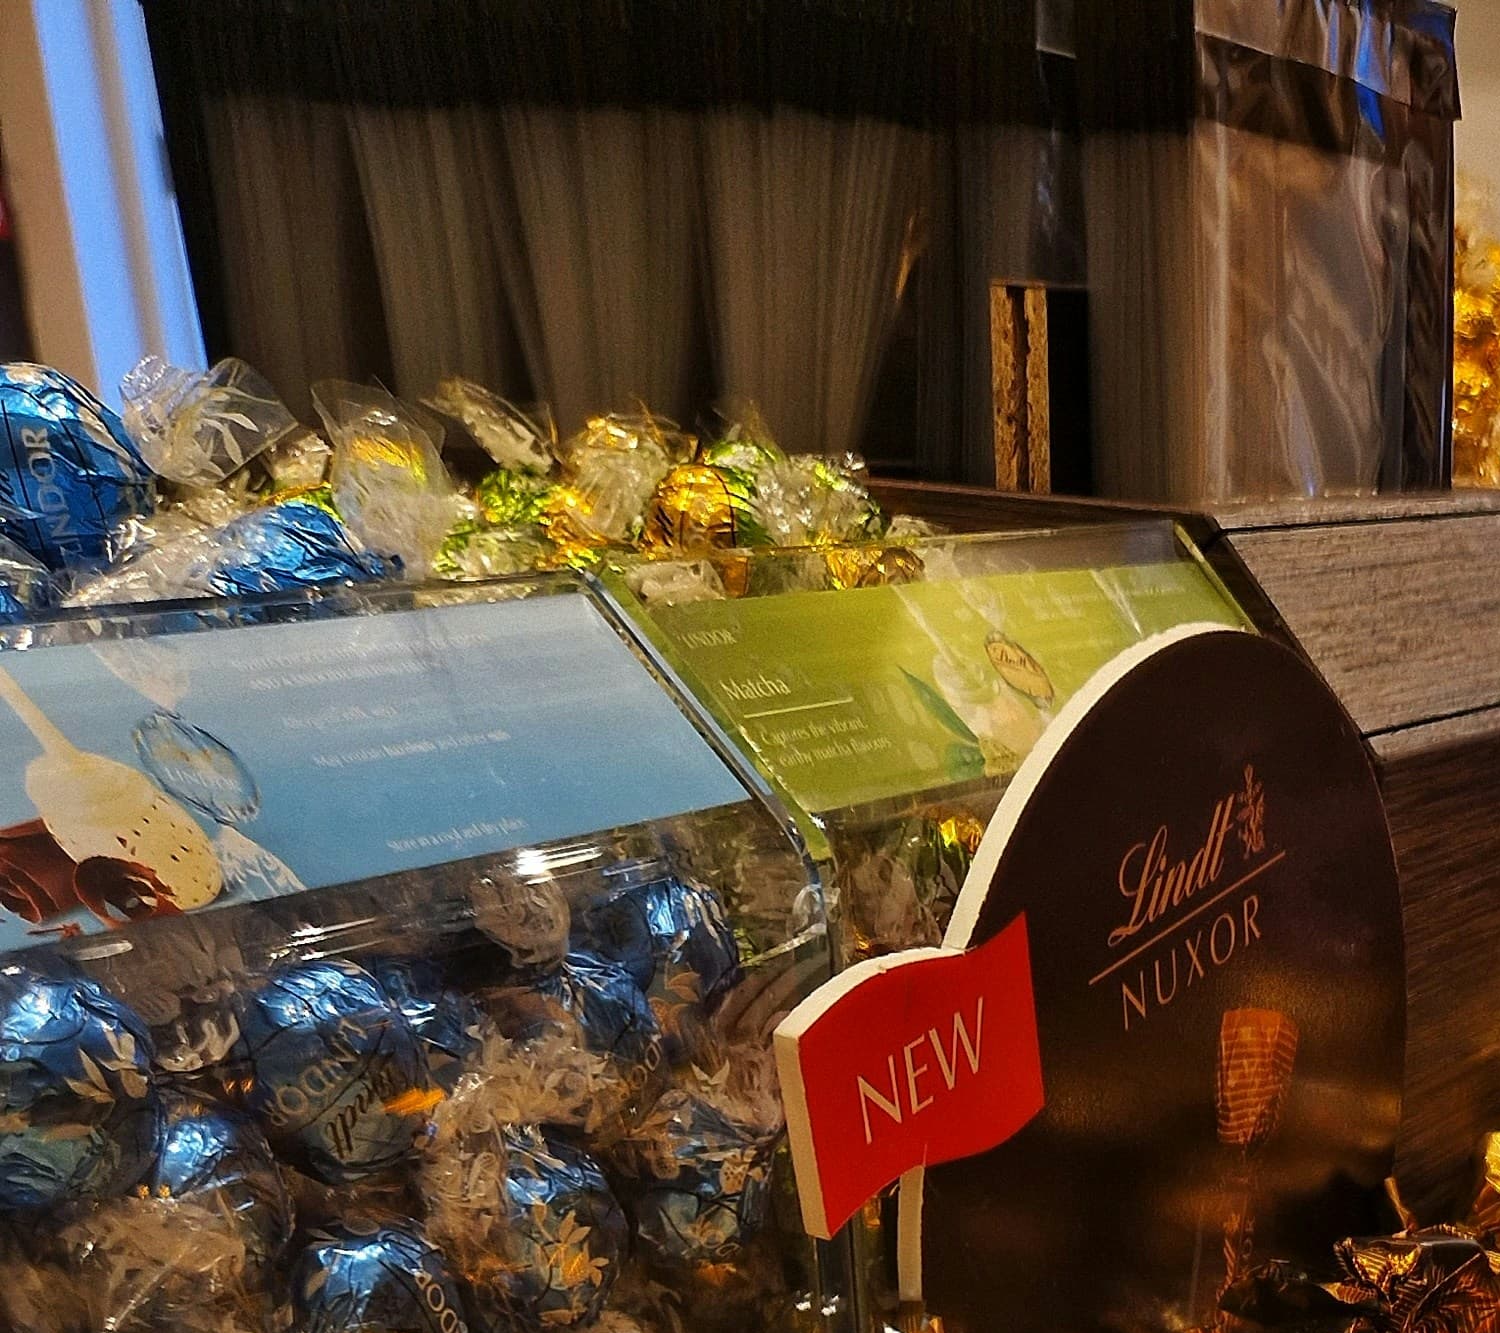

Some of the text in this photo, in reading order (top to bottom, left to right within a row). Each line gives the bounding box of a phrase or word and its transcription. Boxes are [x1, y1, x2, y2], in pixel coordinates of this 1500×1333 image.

[720, 673, 791, 702] Matcha
[1108, 793, 1234, 947] Lindt
[1121, 895, 1262, 1031] NUXOR
[857, 997, 984, 1144] NEW
